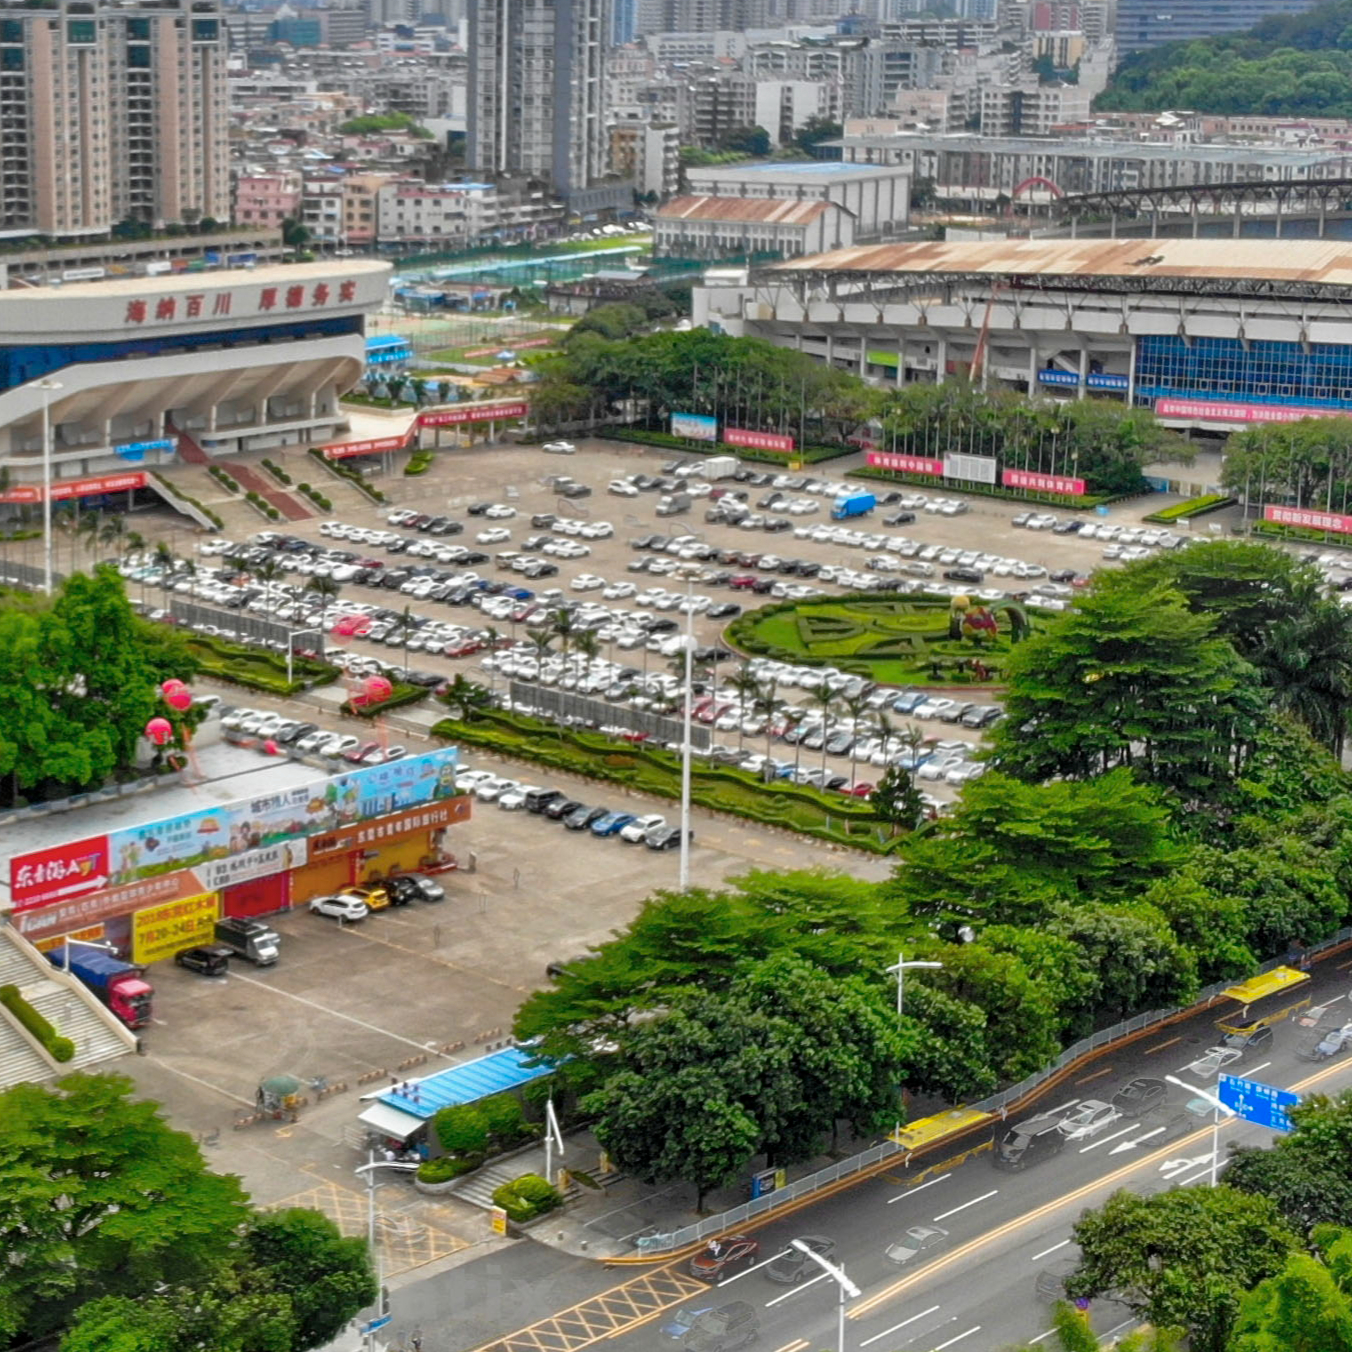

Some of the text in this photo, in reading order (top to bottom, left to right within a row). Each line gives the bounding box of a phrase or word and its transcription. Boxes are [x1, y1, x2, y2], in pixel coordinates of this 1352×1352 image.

[125, 280, 356, 323] 海纳百川 厚德务实
